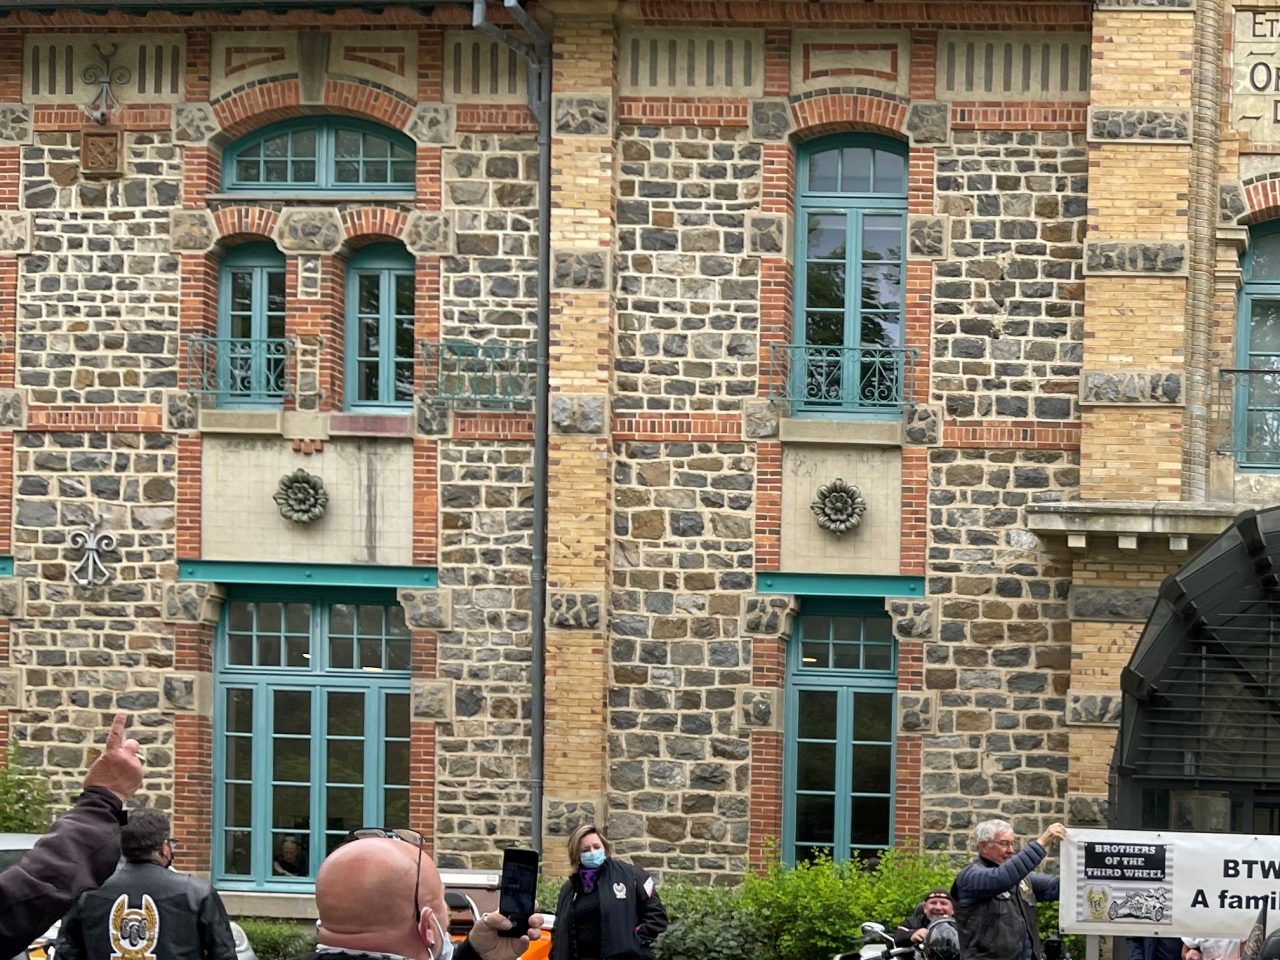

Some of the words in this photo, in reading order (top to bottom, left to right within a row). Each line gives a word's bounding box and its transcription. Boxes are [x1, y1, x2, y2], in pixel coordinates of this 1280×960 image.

[1094, 844, 1157, 855] BROTHERS
[1105, 856, 1120, 866] OF
[1122, 857, 1145, 867] THE
[1086, 867, 1122, 878] THIRD
[1123, 869, 1164, 879] WHEEL
[1190, 888, 1210, 909] A
